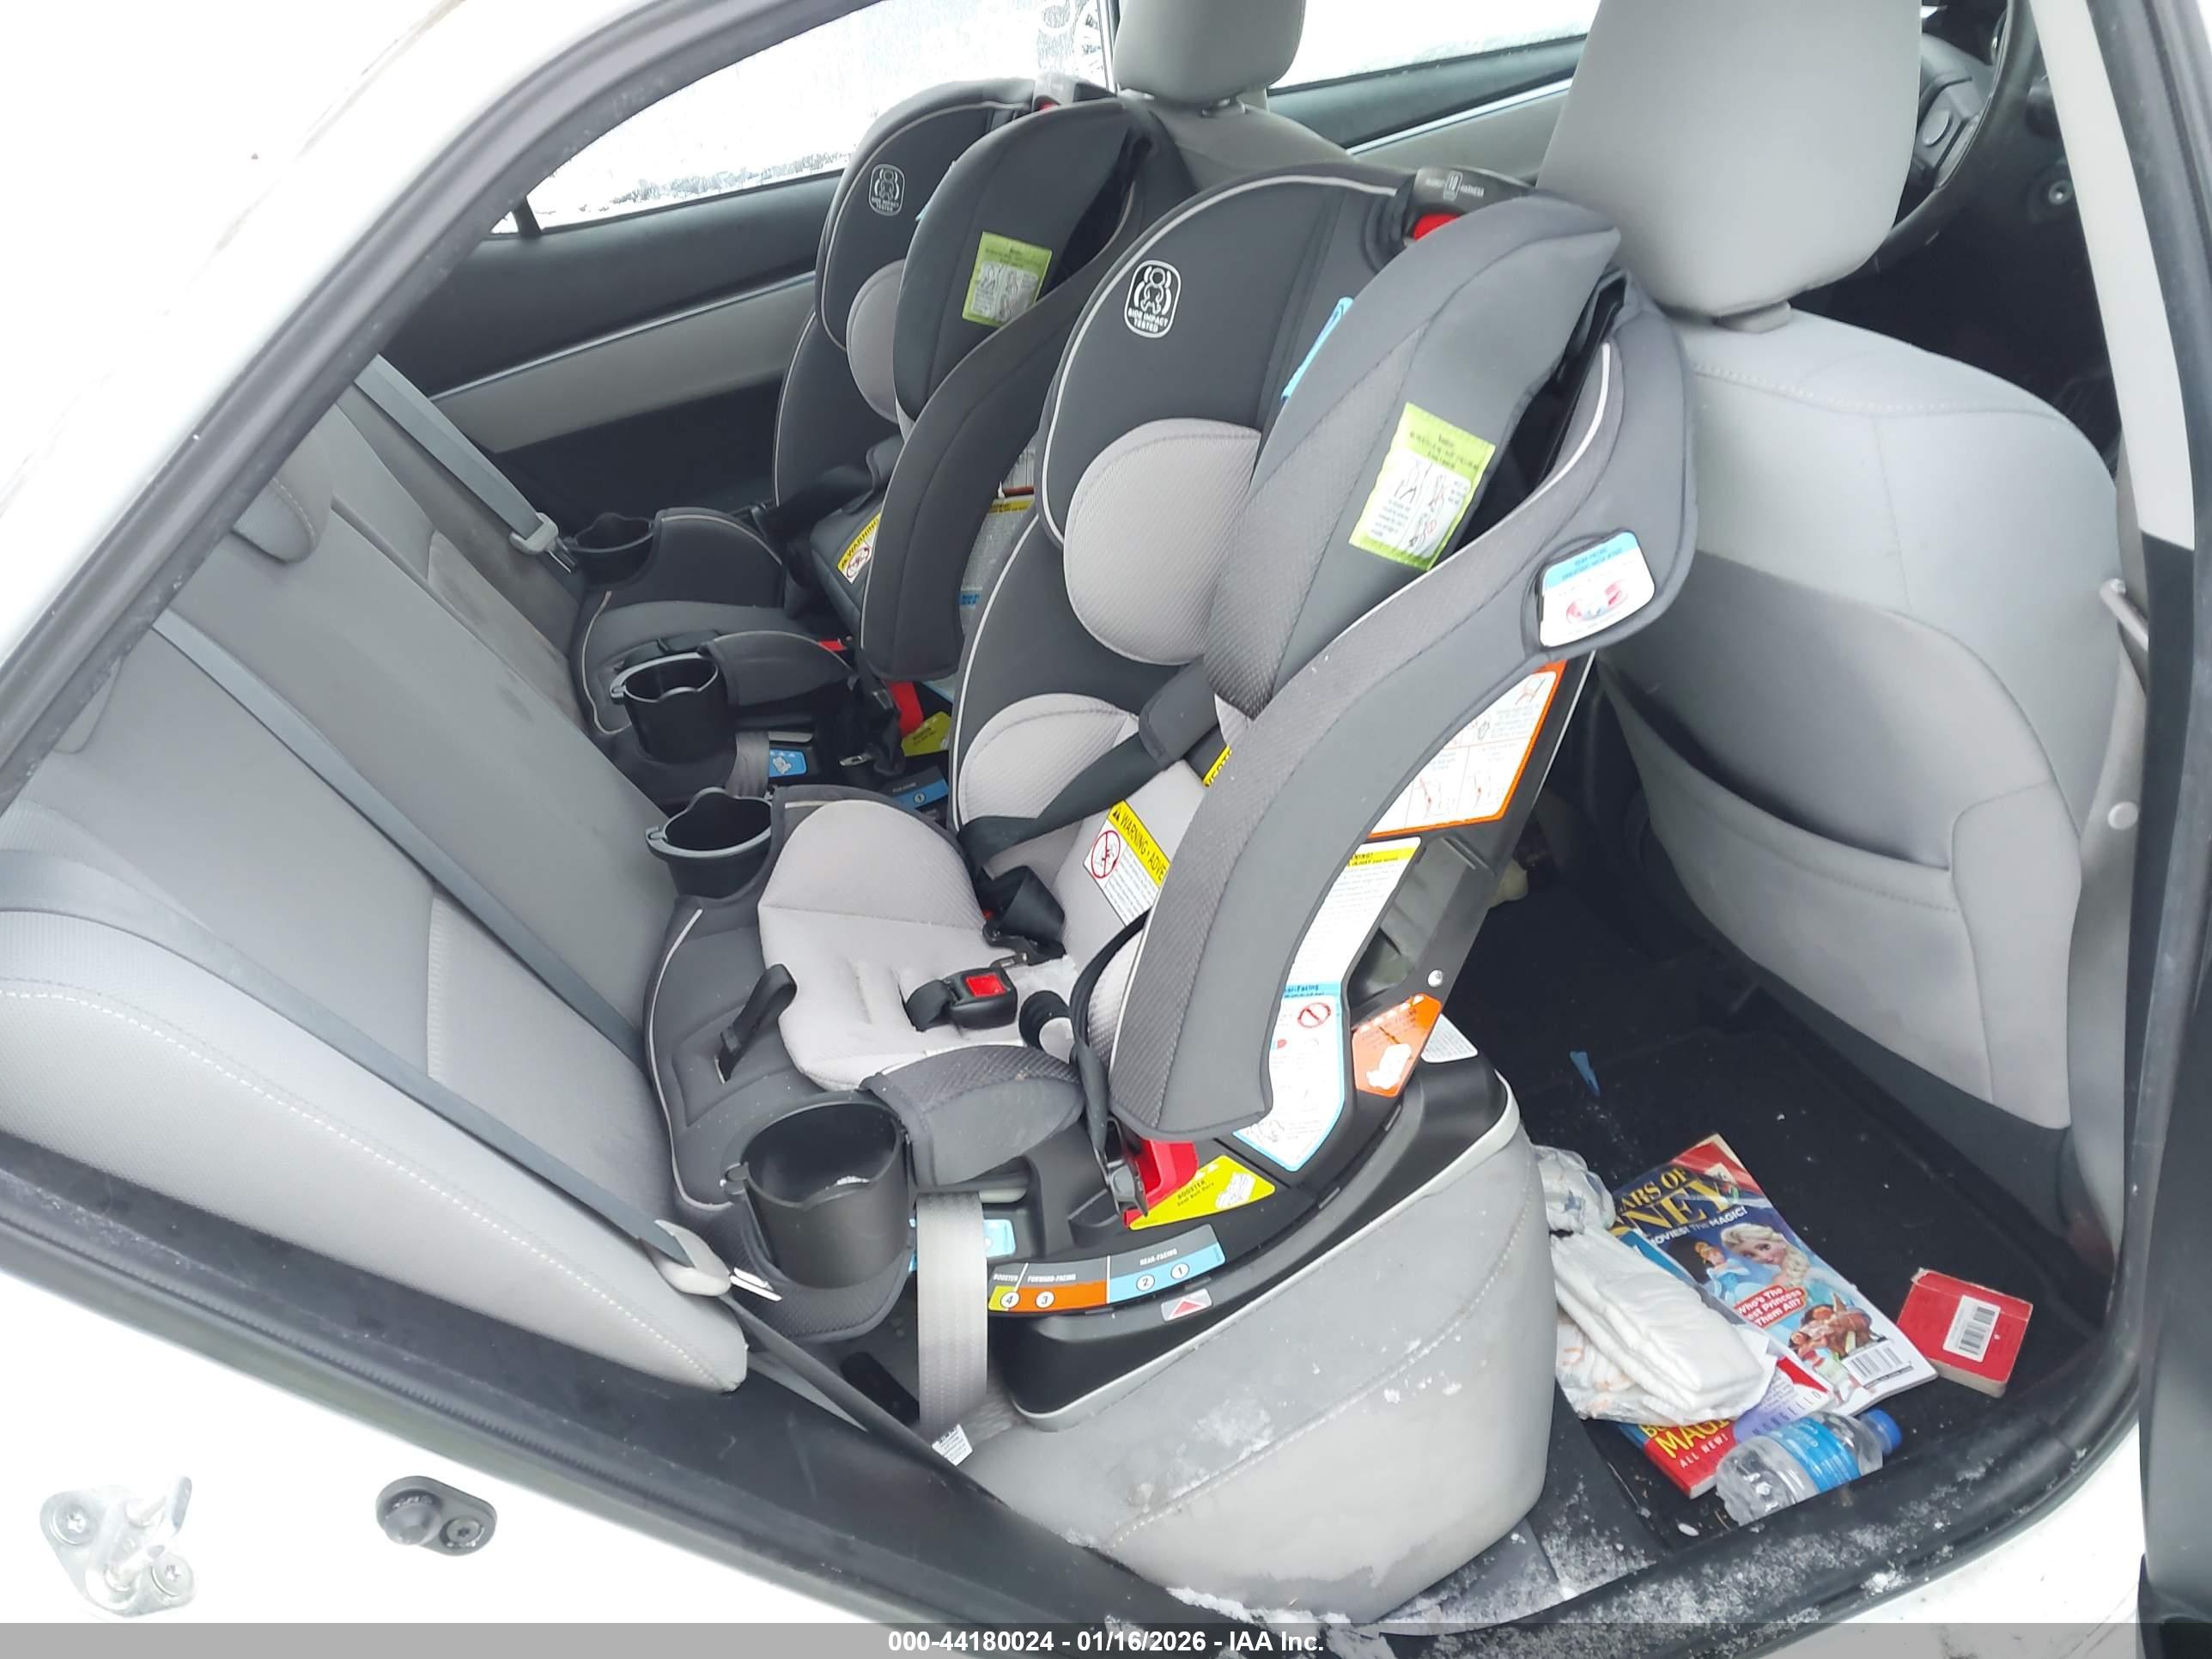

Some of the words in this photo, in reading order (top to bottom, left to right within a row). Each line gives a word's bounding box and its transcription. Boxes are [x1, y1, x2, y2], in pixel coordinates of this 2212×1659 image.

[1133, 317, 1159, 333] TESTED
[1143, 312, 1169, 327] IMPACT
[1120, 816, 1149, 856] WARNING
[1620, 1180, 1662, 1212] ARS
[1660, 1167, 1688, 1189] OF
[1708, 1205, 1748, 1228] MAGIC!
[1761, 1289, 1802, 1312] Princess
[1679, 1452, 1700, 1469] ALL
[1700, 1433, 1729, 1454] NEW!
